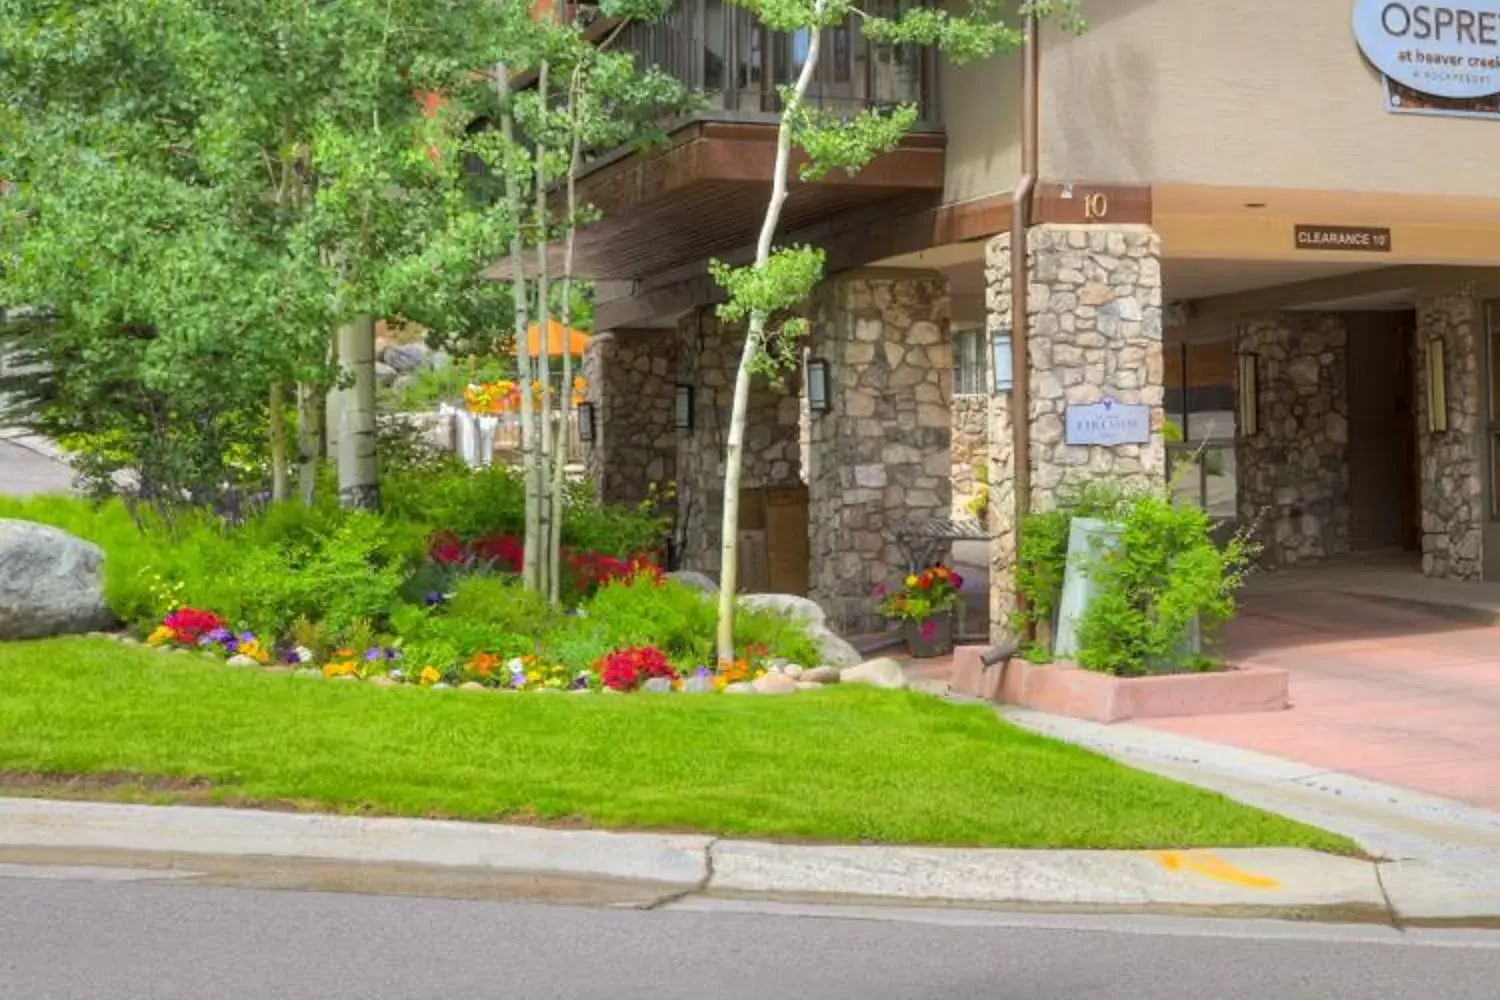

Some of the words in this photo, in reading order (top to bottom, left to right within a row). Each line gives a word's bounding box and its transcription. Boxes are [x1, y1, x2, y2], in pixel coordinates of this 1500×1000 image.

[1398, 50, 1412, 63] at
[1415, 48, 1464, 67] beaver
[1084, 192, 1107, 217] 10
[1298, 230, 1370, 246] CLEARANCE
